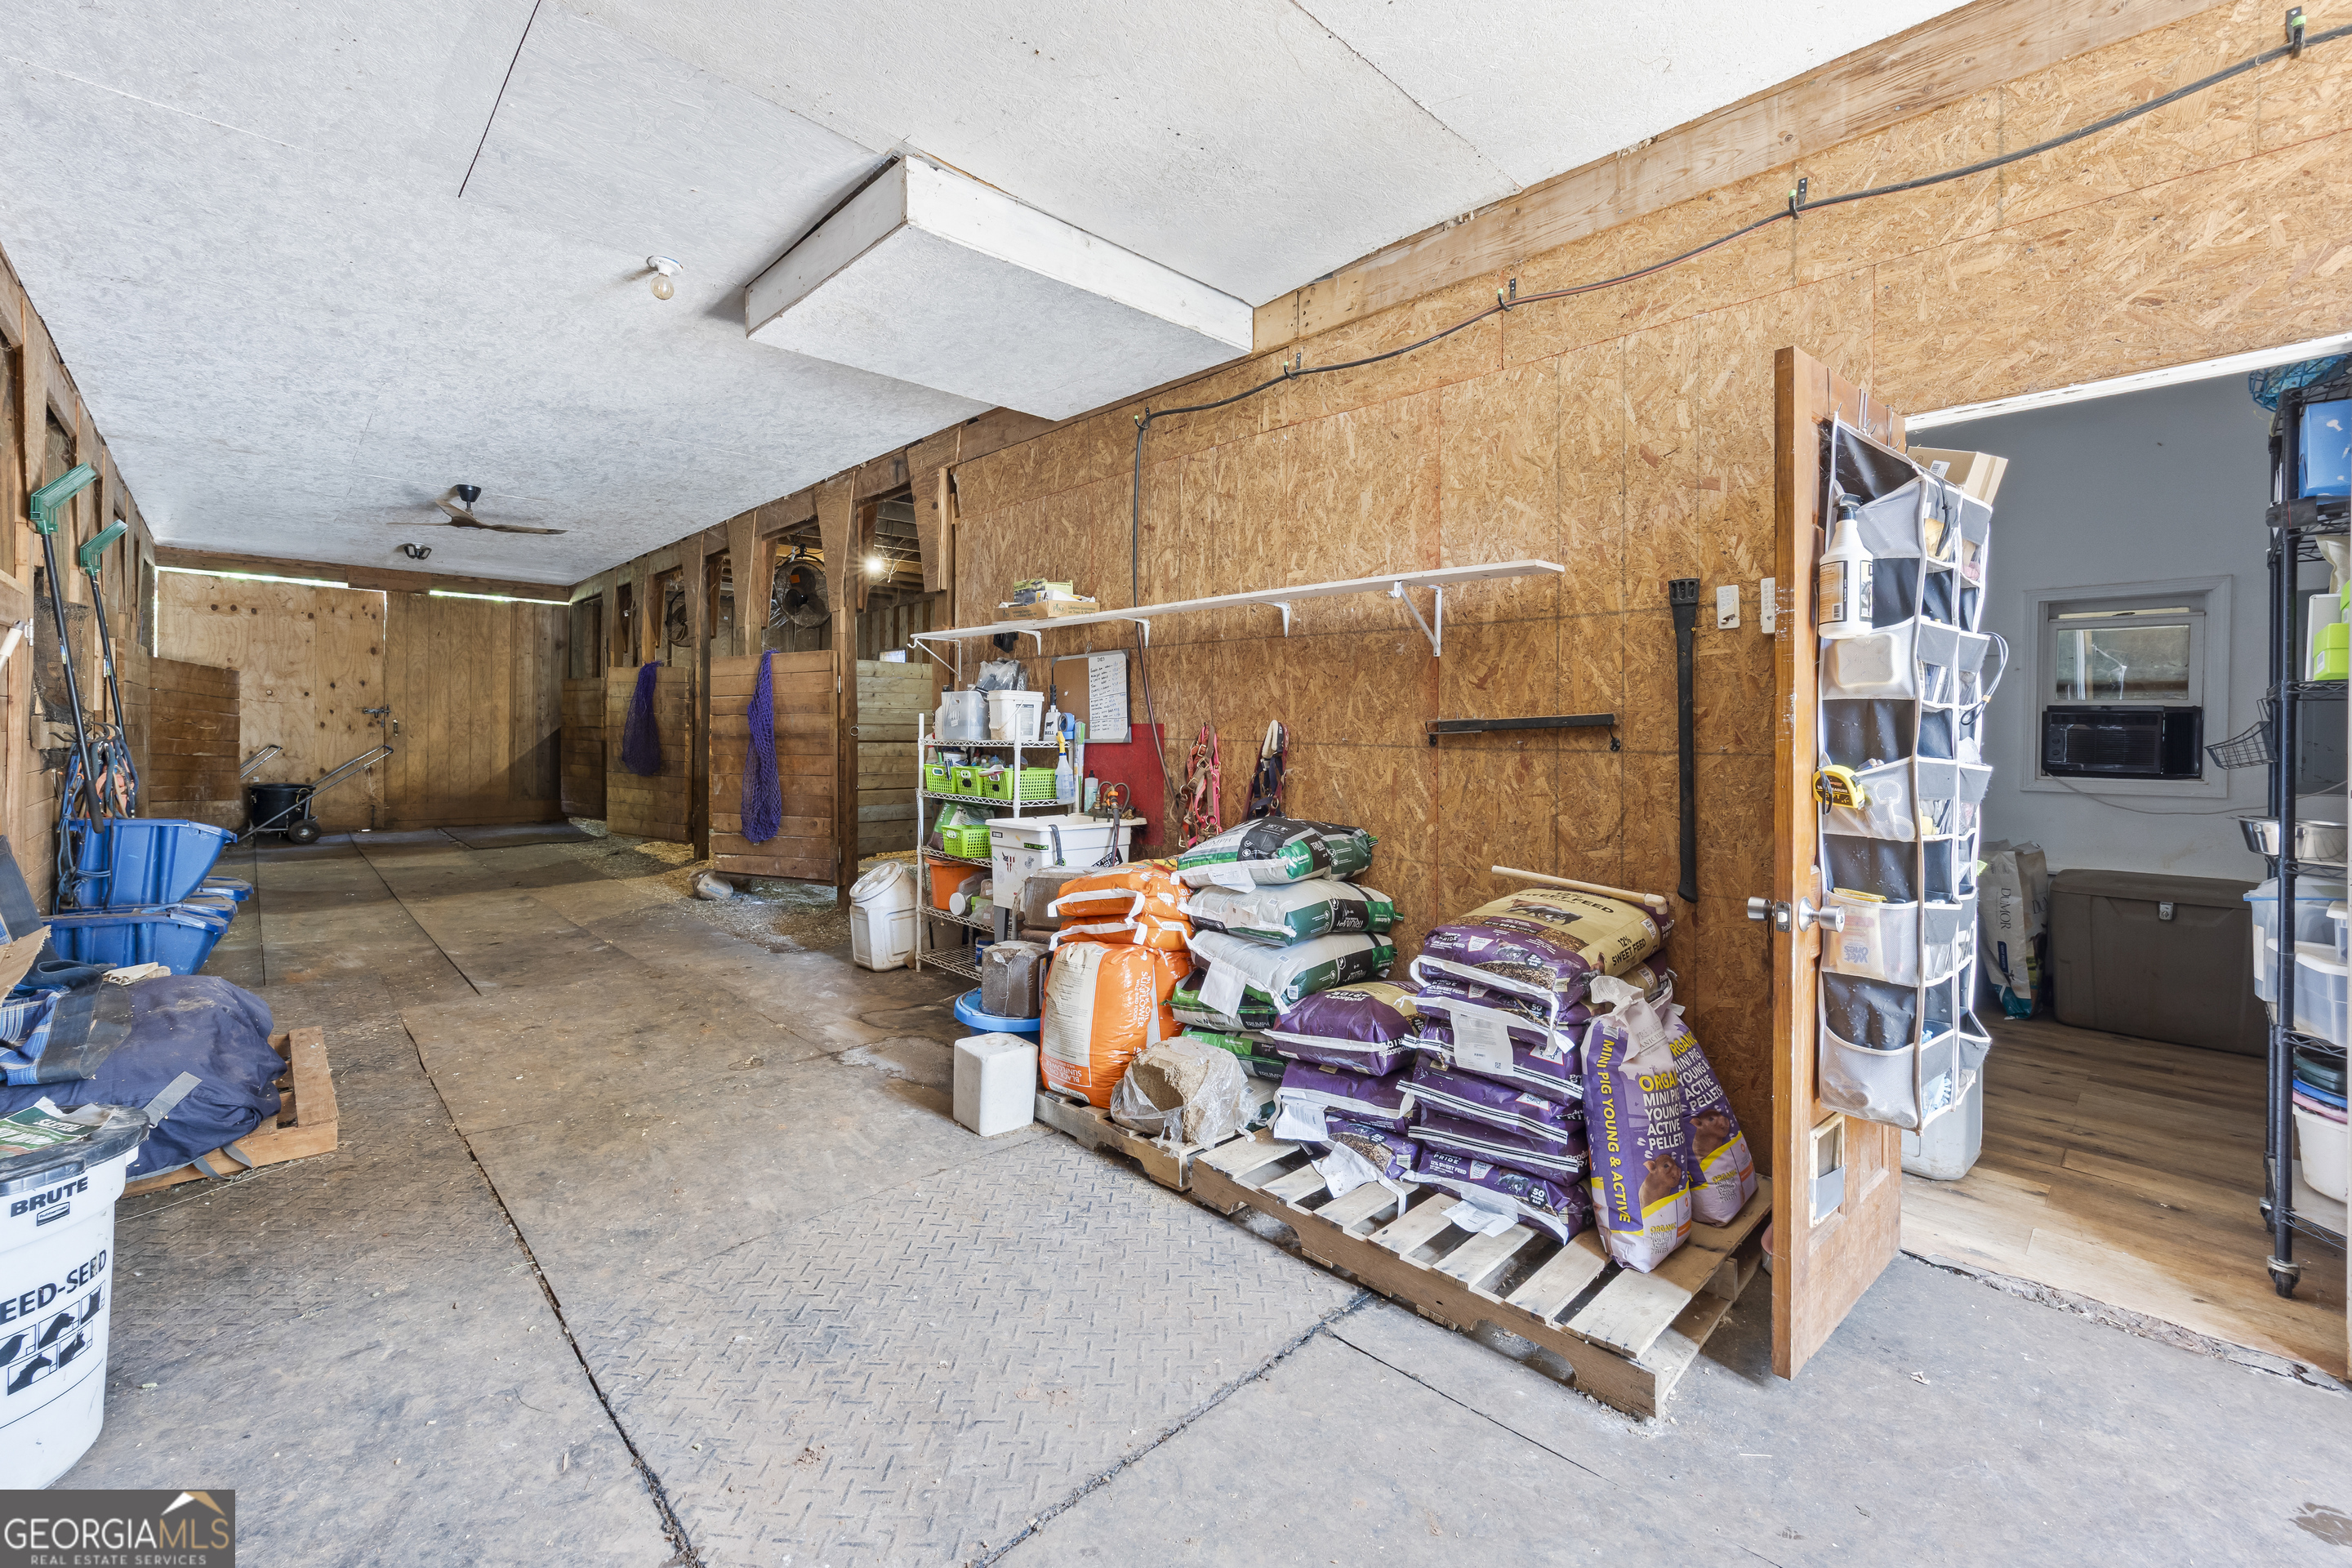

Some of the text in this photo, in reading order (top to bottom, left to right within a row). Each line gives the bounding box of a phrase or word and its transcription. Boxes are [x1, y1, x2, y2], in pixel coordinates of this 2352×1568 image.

[1197, 837, 1232, 849] RIUMPH
[1572, 898, 1615, 914] FEED
[1617, 934, 1633, 948] 12%
[1611, 938, 1646, 966] SWEET FEED
[1137, 970, 1148, 1029] SUNFLOWER
[1531, 1003, 1543, 1012] 50
[1669, 1031, 1698, 1057] RGANIC
[1690, 1047, 1702, 1062] PIG
[1046, 1059, 1082, 1077] SUNFLOWER
[1677, 1062, 1706, 1087] YOUNG
[1060, 1072, 1080, 1083] BLACK
[1638, 1071, 1678, 1092] ORGA
[1684, 1074, 1714, 1101] ACTIVE
[1642, 1090, 1669, 1107] MINI
[1690, 1085, 1723, 1111] PELLETS
[1644, 1104, 1679, 1121] YOUNG
[1596, 1039, 1631, 1223] MINI PIG YOUNG & ACTIVE
[1647, 1119, 1681, 1136] ACTIVE
[1648, 1133, 1684, 1151] PELLETS
[1433, 1153, 1459, 1165] PRIDE
[1438, 1162, 1454, 1171] SWEET
[1454, 1166, 1467, 1175] FEED
[1712, 1168, 1738, 1183] ORGANIC
[11, 1176, 89, 1218] BRUTE
[1530, 1194, 1545, 1202] POUND
[1531, 1187, 1545, 1198] 50
[1650, 1222, 1677, 1233] ORGANIC
[0, 1250, 107, 1325] EED-SEED
